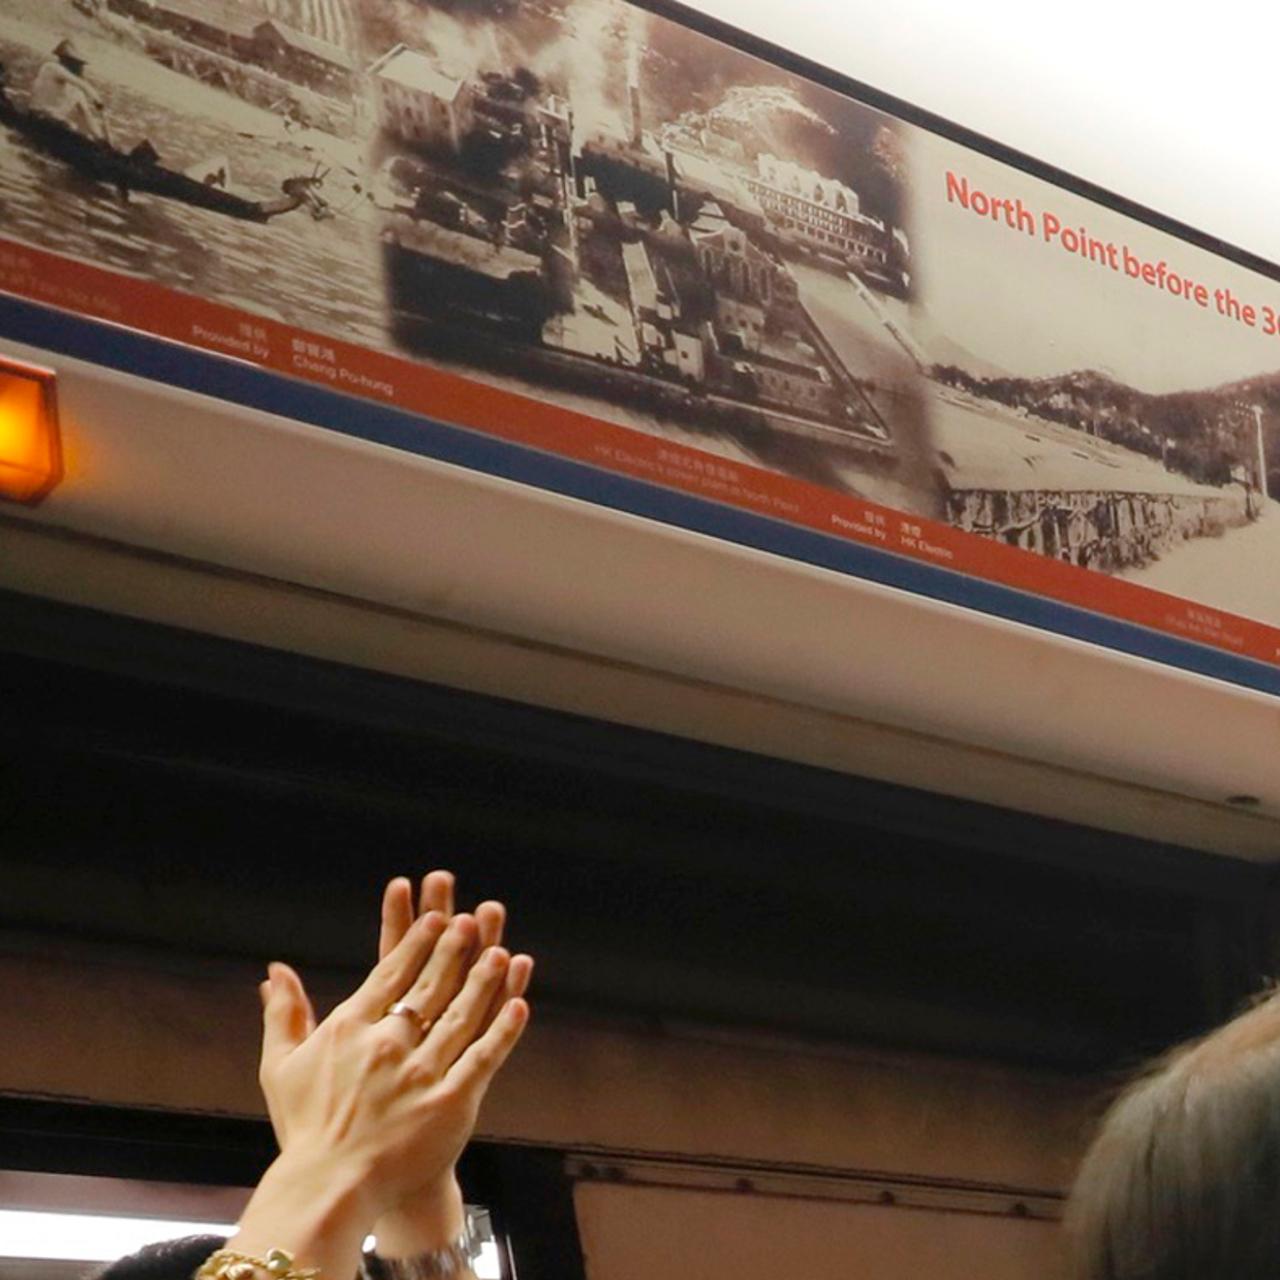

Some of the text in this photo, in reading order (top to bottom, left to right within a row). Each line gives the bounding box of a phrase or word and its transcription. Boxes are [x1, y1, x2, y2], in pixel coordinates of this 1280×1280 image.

[945, 171, 1035, 236] North
[1042, 212, 1119, 271] Point
[1123, 246, 1208, 307] before
[1214, 289, 1256, 327] the
